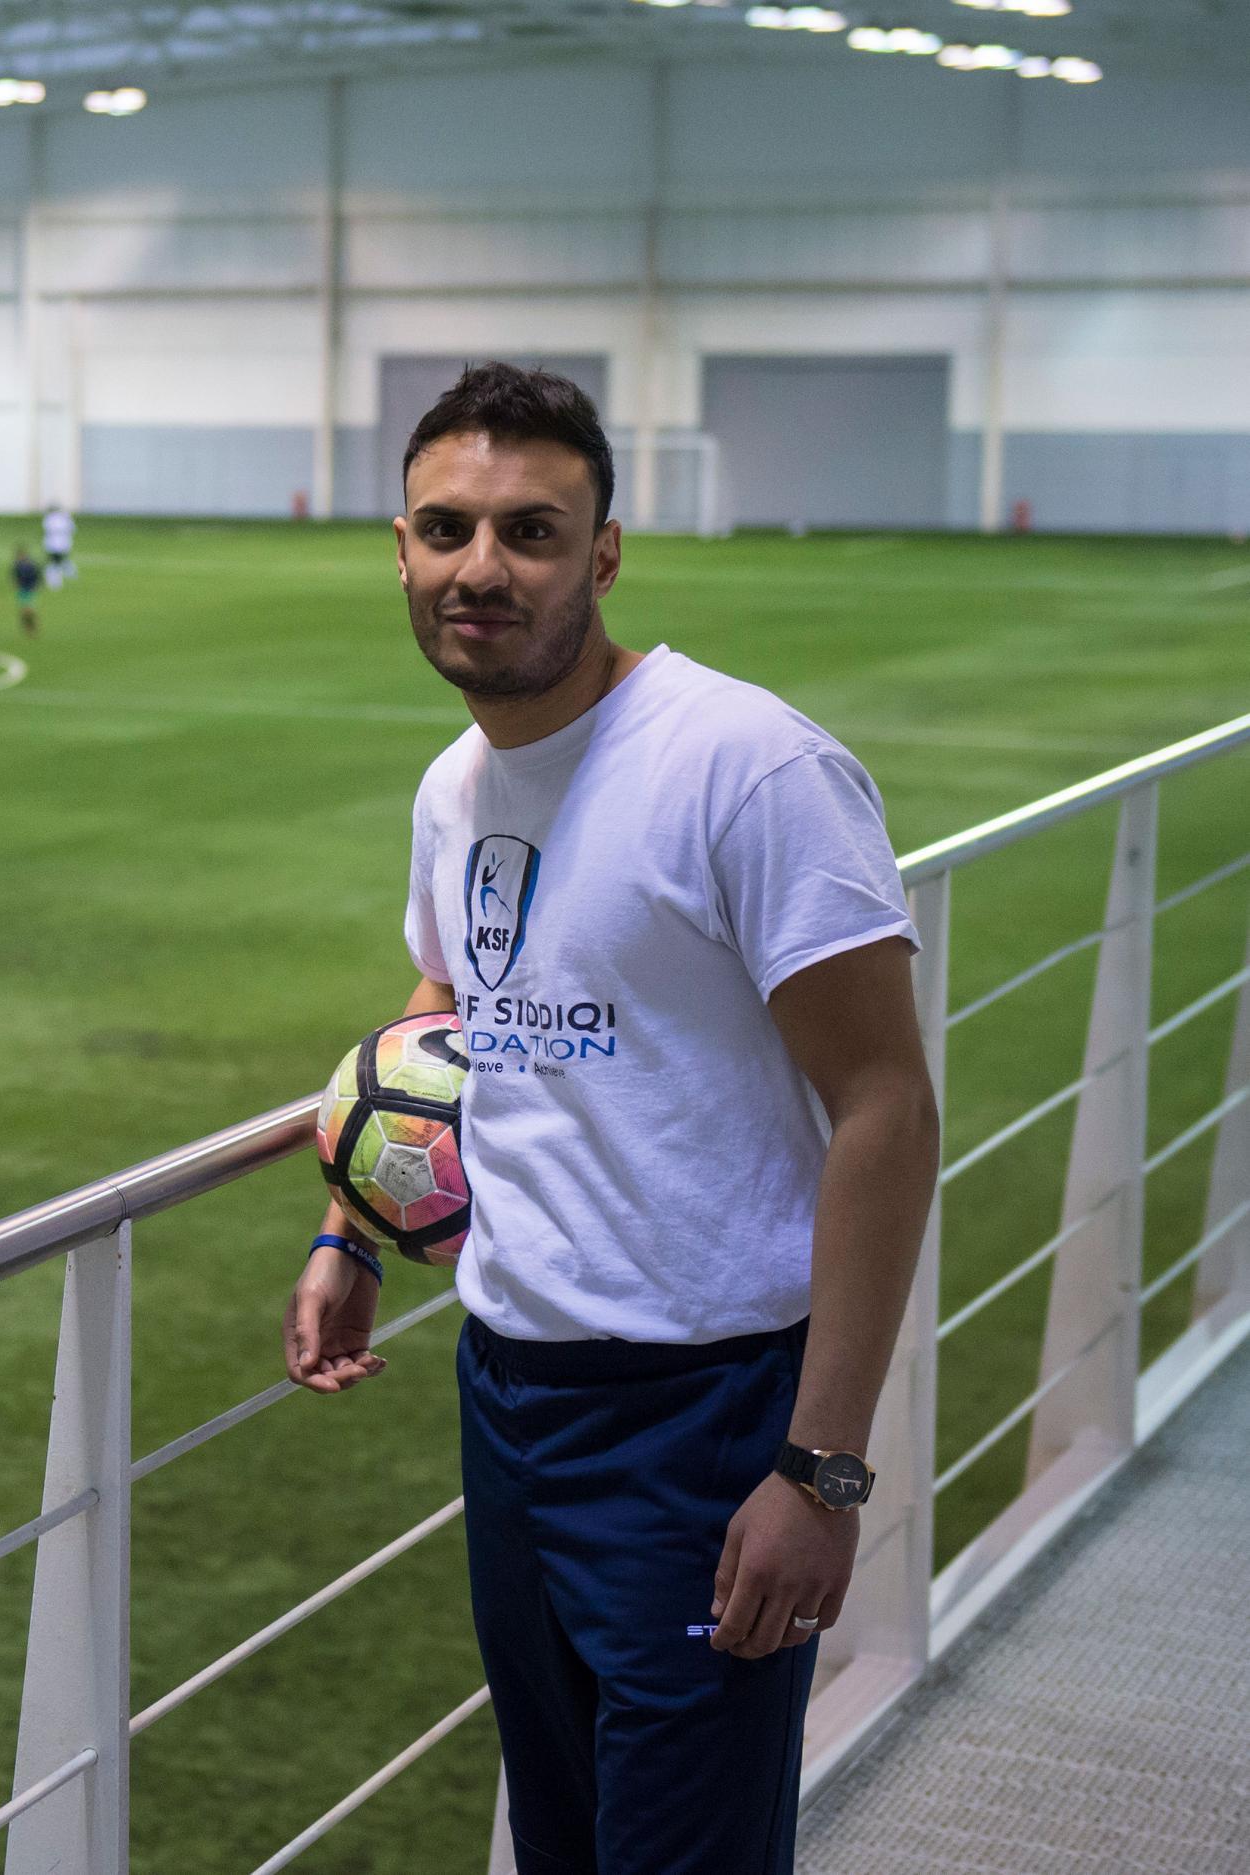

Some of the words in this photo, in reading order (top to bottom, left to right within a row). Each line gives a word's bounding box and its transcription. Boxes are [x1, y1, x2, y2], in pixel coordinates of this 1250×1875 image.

[476, 926, 510, 951] KSF
[494, 997, 616, 1033] SIDDIQI
[466, 1030, 616, 1060] DATION
[687, 1625, 719, 1636] ST
